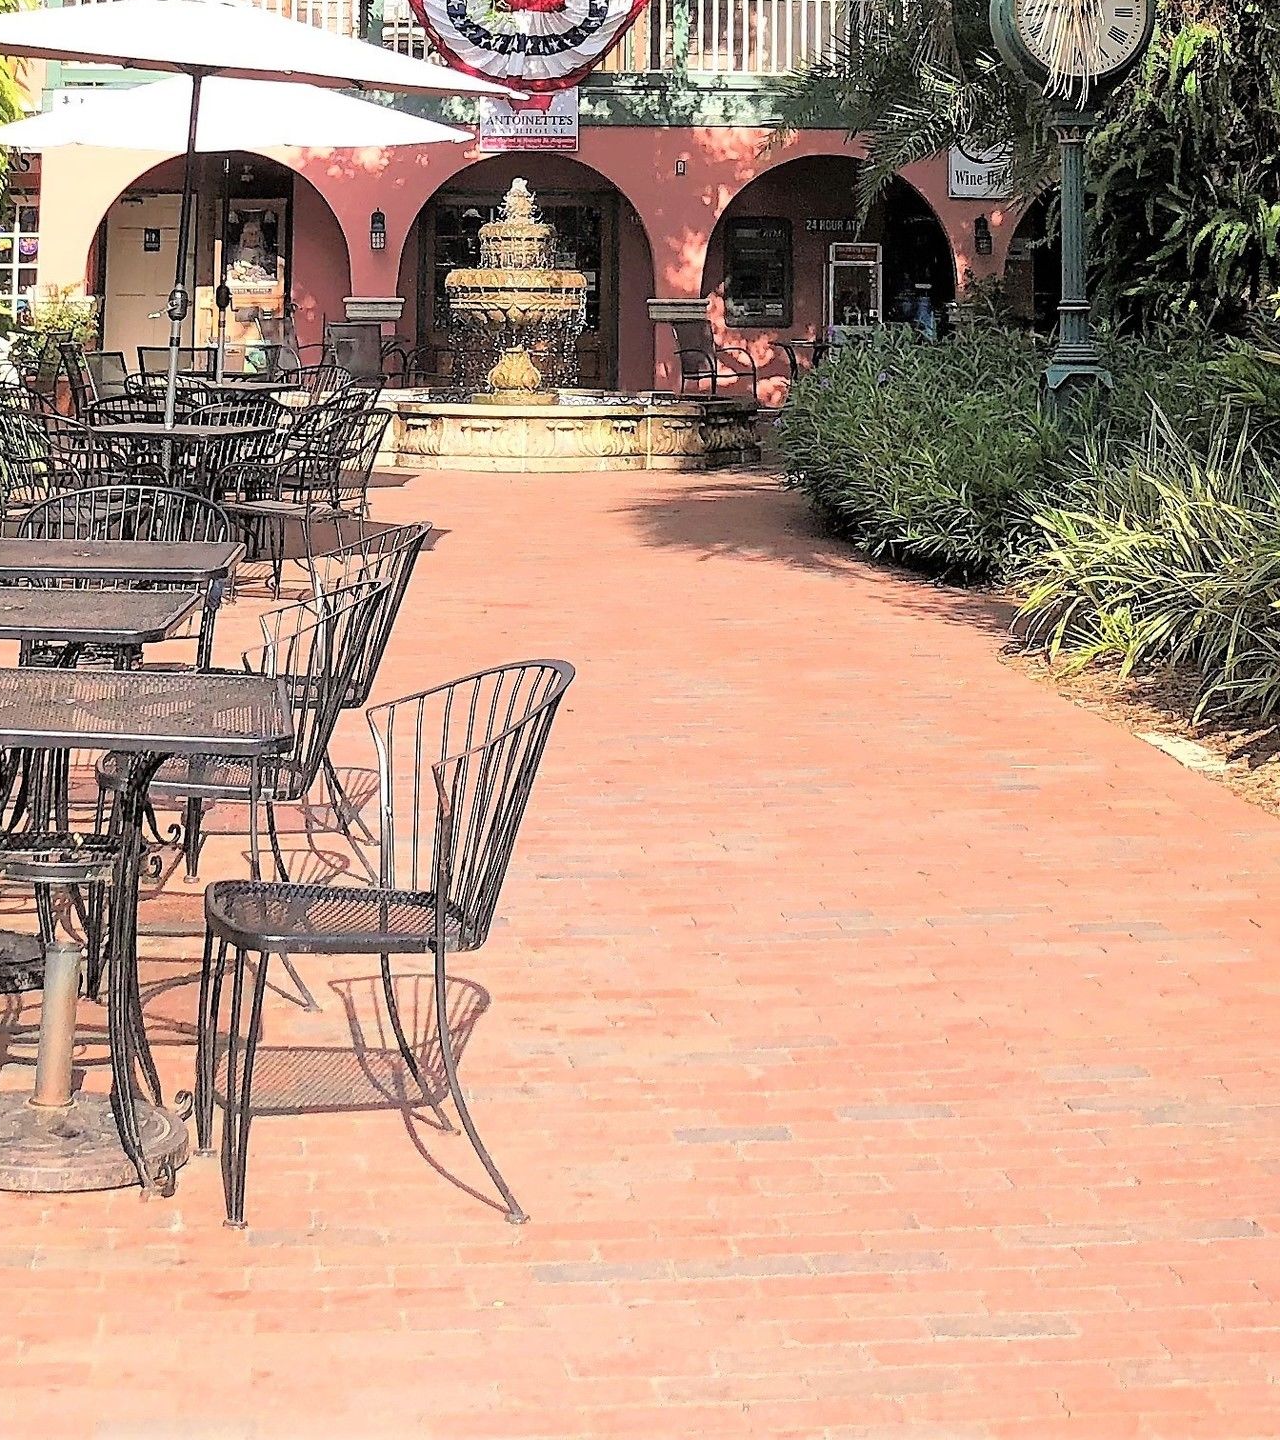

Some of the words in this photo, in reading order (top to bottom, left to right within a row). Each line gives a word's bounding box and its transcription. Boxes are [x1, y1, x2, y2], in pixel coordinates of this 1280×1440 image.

[955, 169, 983, 186] Wine
[806, 219, 817, 231] 24
[819, 219, 844, 231] HOUR
